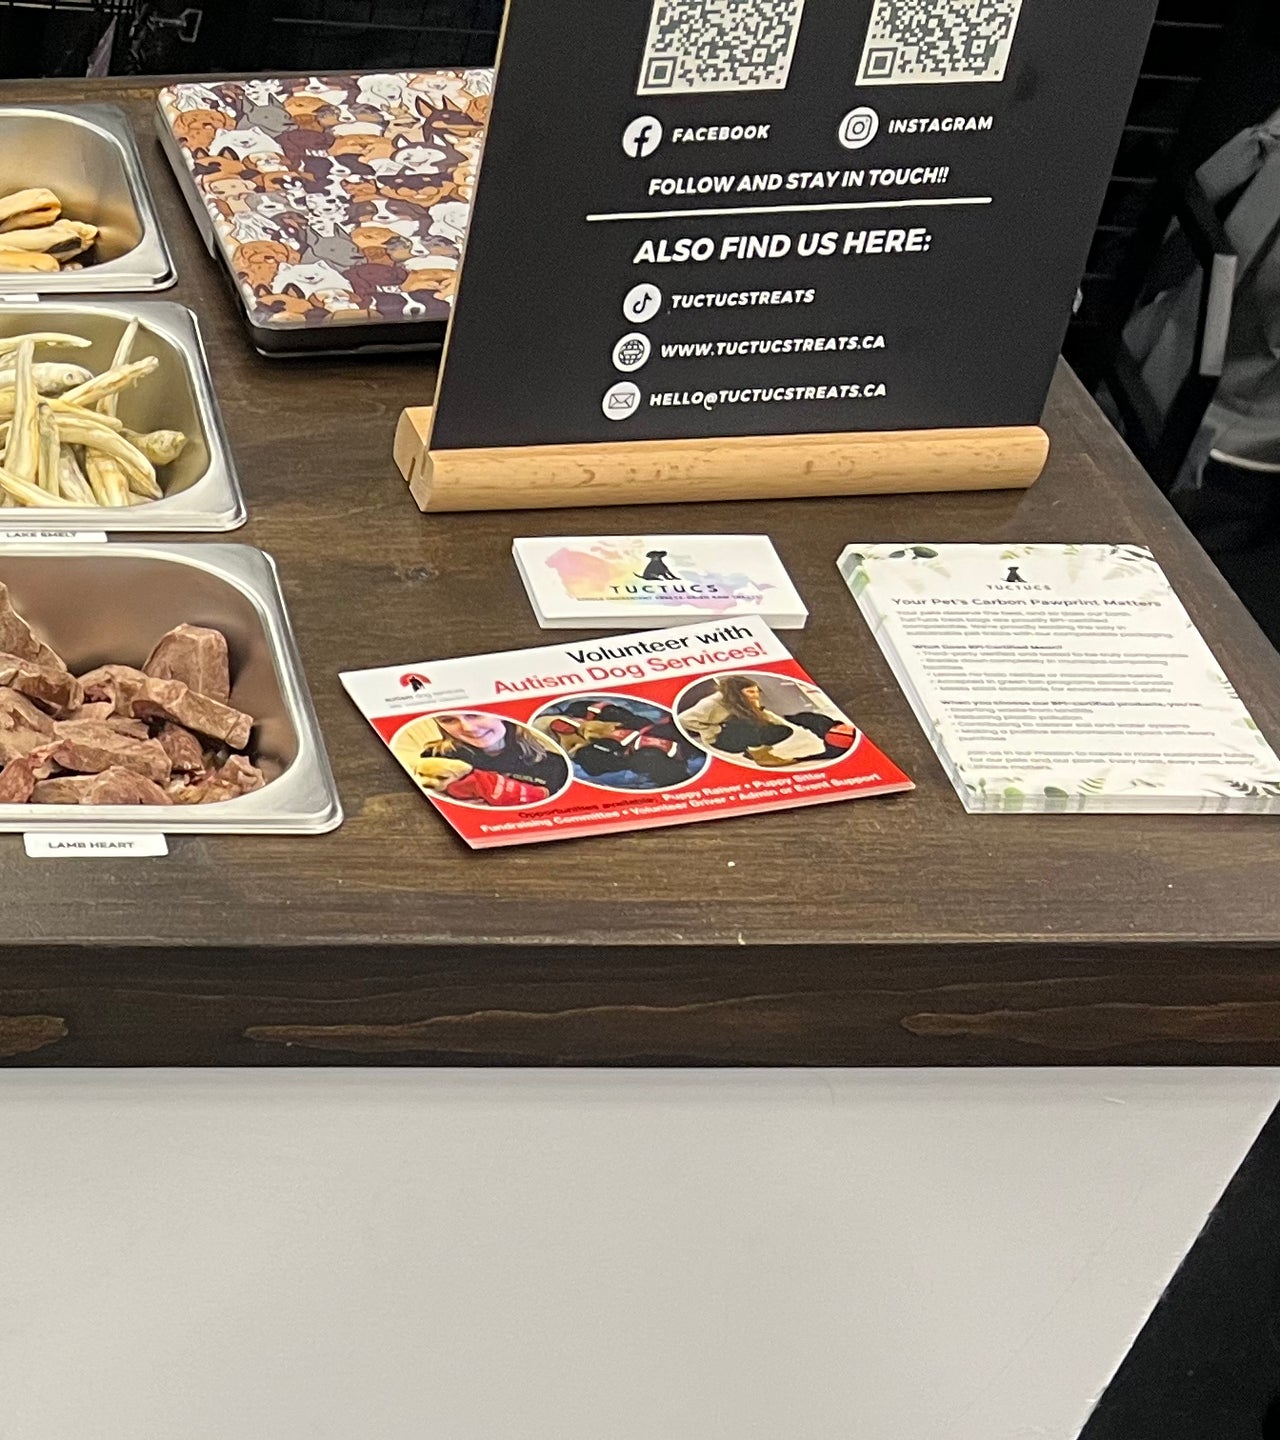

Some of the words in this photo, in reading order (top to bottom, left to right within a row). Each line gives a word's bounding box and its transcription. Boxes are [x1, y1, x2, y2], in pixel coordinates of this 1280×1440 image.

[672, 124, 770, 143] FACEBOOK
[888, 116, 993, 134] INSTAGRAM
[648, 174, 738, 196] FOLLOW
[736, 172, 782, 193] AND
[785, 170, 840, 190] STAY
[841, 168, 865, 188] IN
[869, 166, 950, 187] TOUCH!!
[633, 236, 716, 264] ALSO
[719, 234, 791, 260] FIND
[797, 231, 838, 257] US
[842, 228, 932, 255] HERE:
[670, 288, 816, 309] TUCTUCSTREATS
[660, 335, 886, 359] WWW.TUCTUCSTREATS.CA
[648, 383, 887, 411] HELLO@TUCTUCSTREATS.CA
[609, 584, 719, 595] TUCTUCS
[891, 598, 928, 606] Your
[931, 598, 968, 606] Pet's
[972, 598, 1027, 606] Carbon
[1030, 599, 1100, 607] Pawprint
[1103, 599, 1162, 607] Matters
[566, 635, 689, 665] Volunteer
[695, 624, 753, 646] with
[494, 672, 583, 695] Autism
[586, 662, 646, 681] Dog
[646, 641, 768, 672] Services!
[661, 791, 701, 802] Puppy
[752, 778, 792, 788] Puppy
[480, 819, 553, 832] Fundraising
[553, 811, 620, 825] Committee
[629, 802, 687, 815] Volunteer
[688, 797, 726, 808] Driver
[738, 789, 778, 800] Admin
[793, 781, 831, 792] Event
[830, 773, 882, 787] Support
